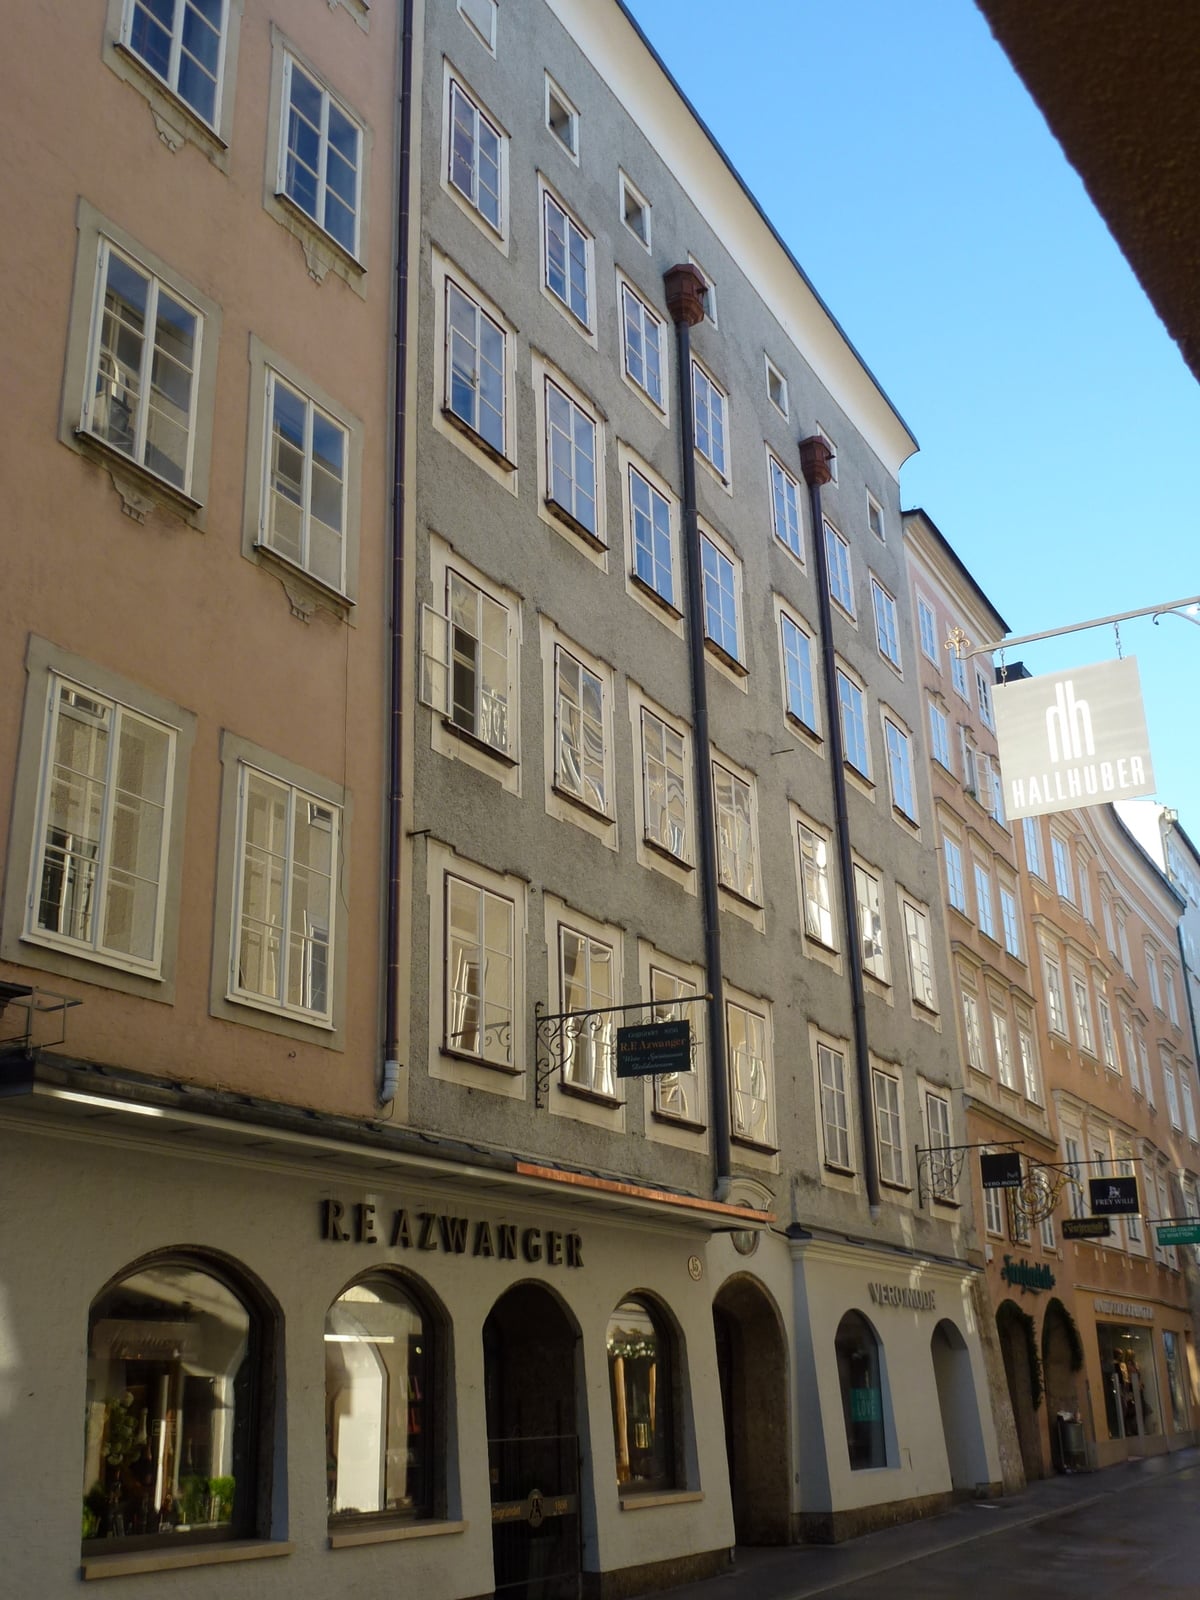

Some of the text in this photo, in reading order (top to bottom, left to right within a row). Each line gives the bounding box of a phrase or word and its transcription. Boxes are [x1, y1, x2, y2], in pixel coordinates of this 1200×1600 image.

[1012, 756, 1145, 808] HALLHUBER
[639, 1038, 686, 1050] Azwanger
[389, 1208, 585, 1269] AZWANGER
[867, 1281, 904, 1307] VERO
